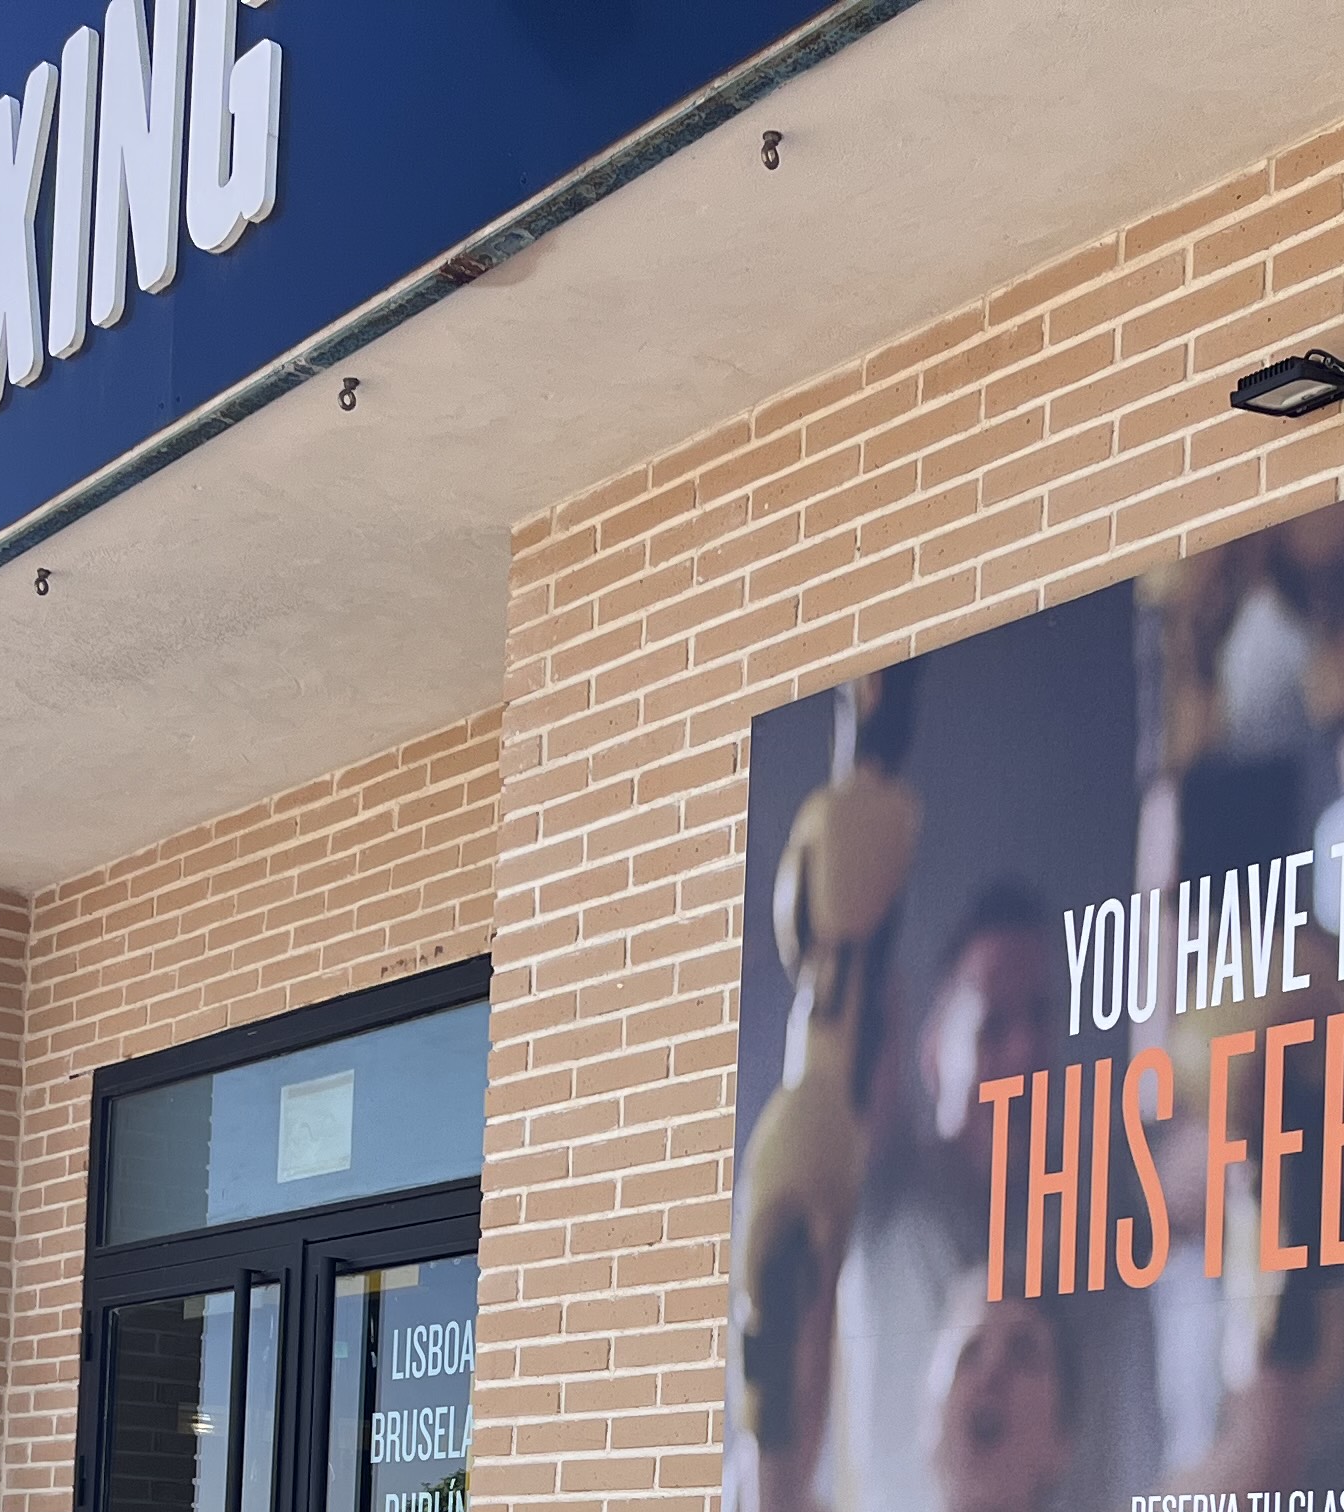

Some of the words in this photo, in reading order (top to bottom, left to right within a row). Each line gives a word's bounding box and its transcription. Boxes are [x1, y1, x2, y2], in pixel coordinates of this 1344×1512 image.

[1064, 888, 1161, 1036] YOU
[1175, 850, 1314, 1015] HAVE
[979, 1046, 1175, 1303] THIS
[391, 1319, 475, 1380] LISBOA
